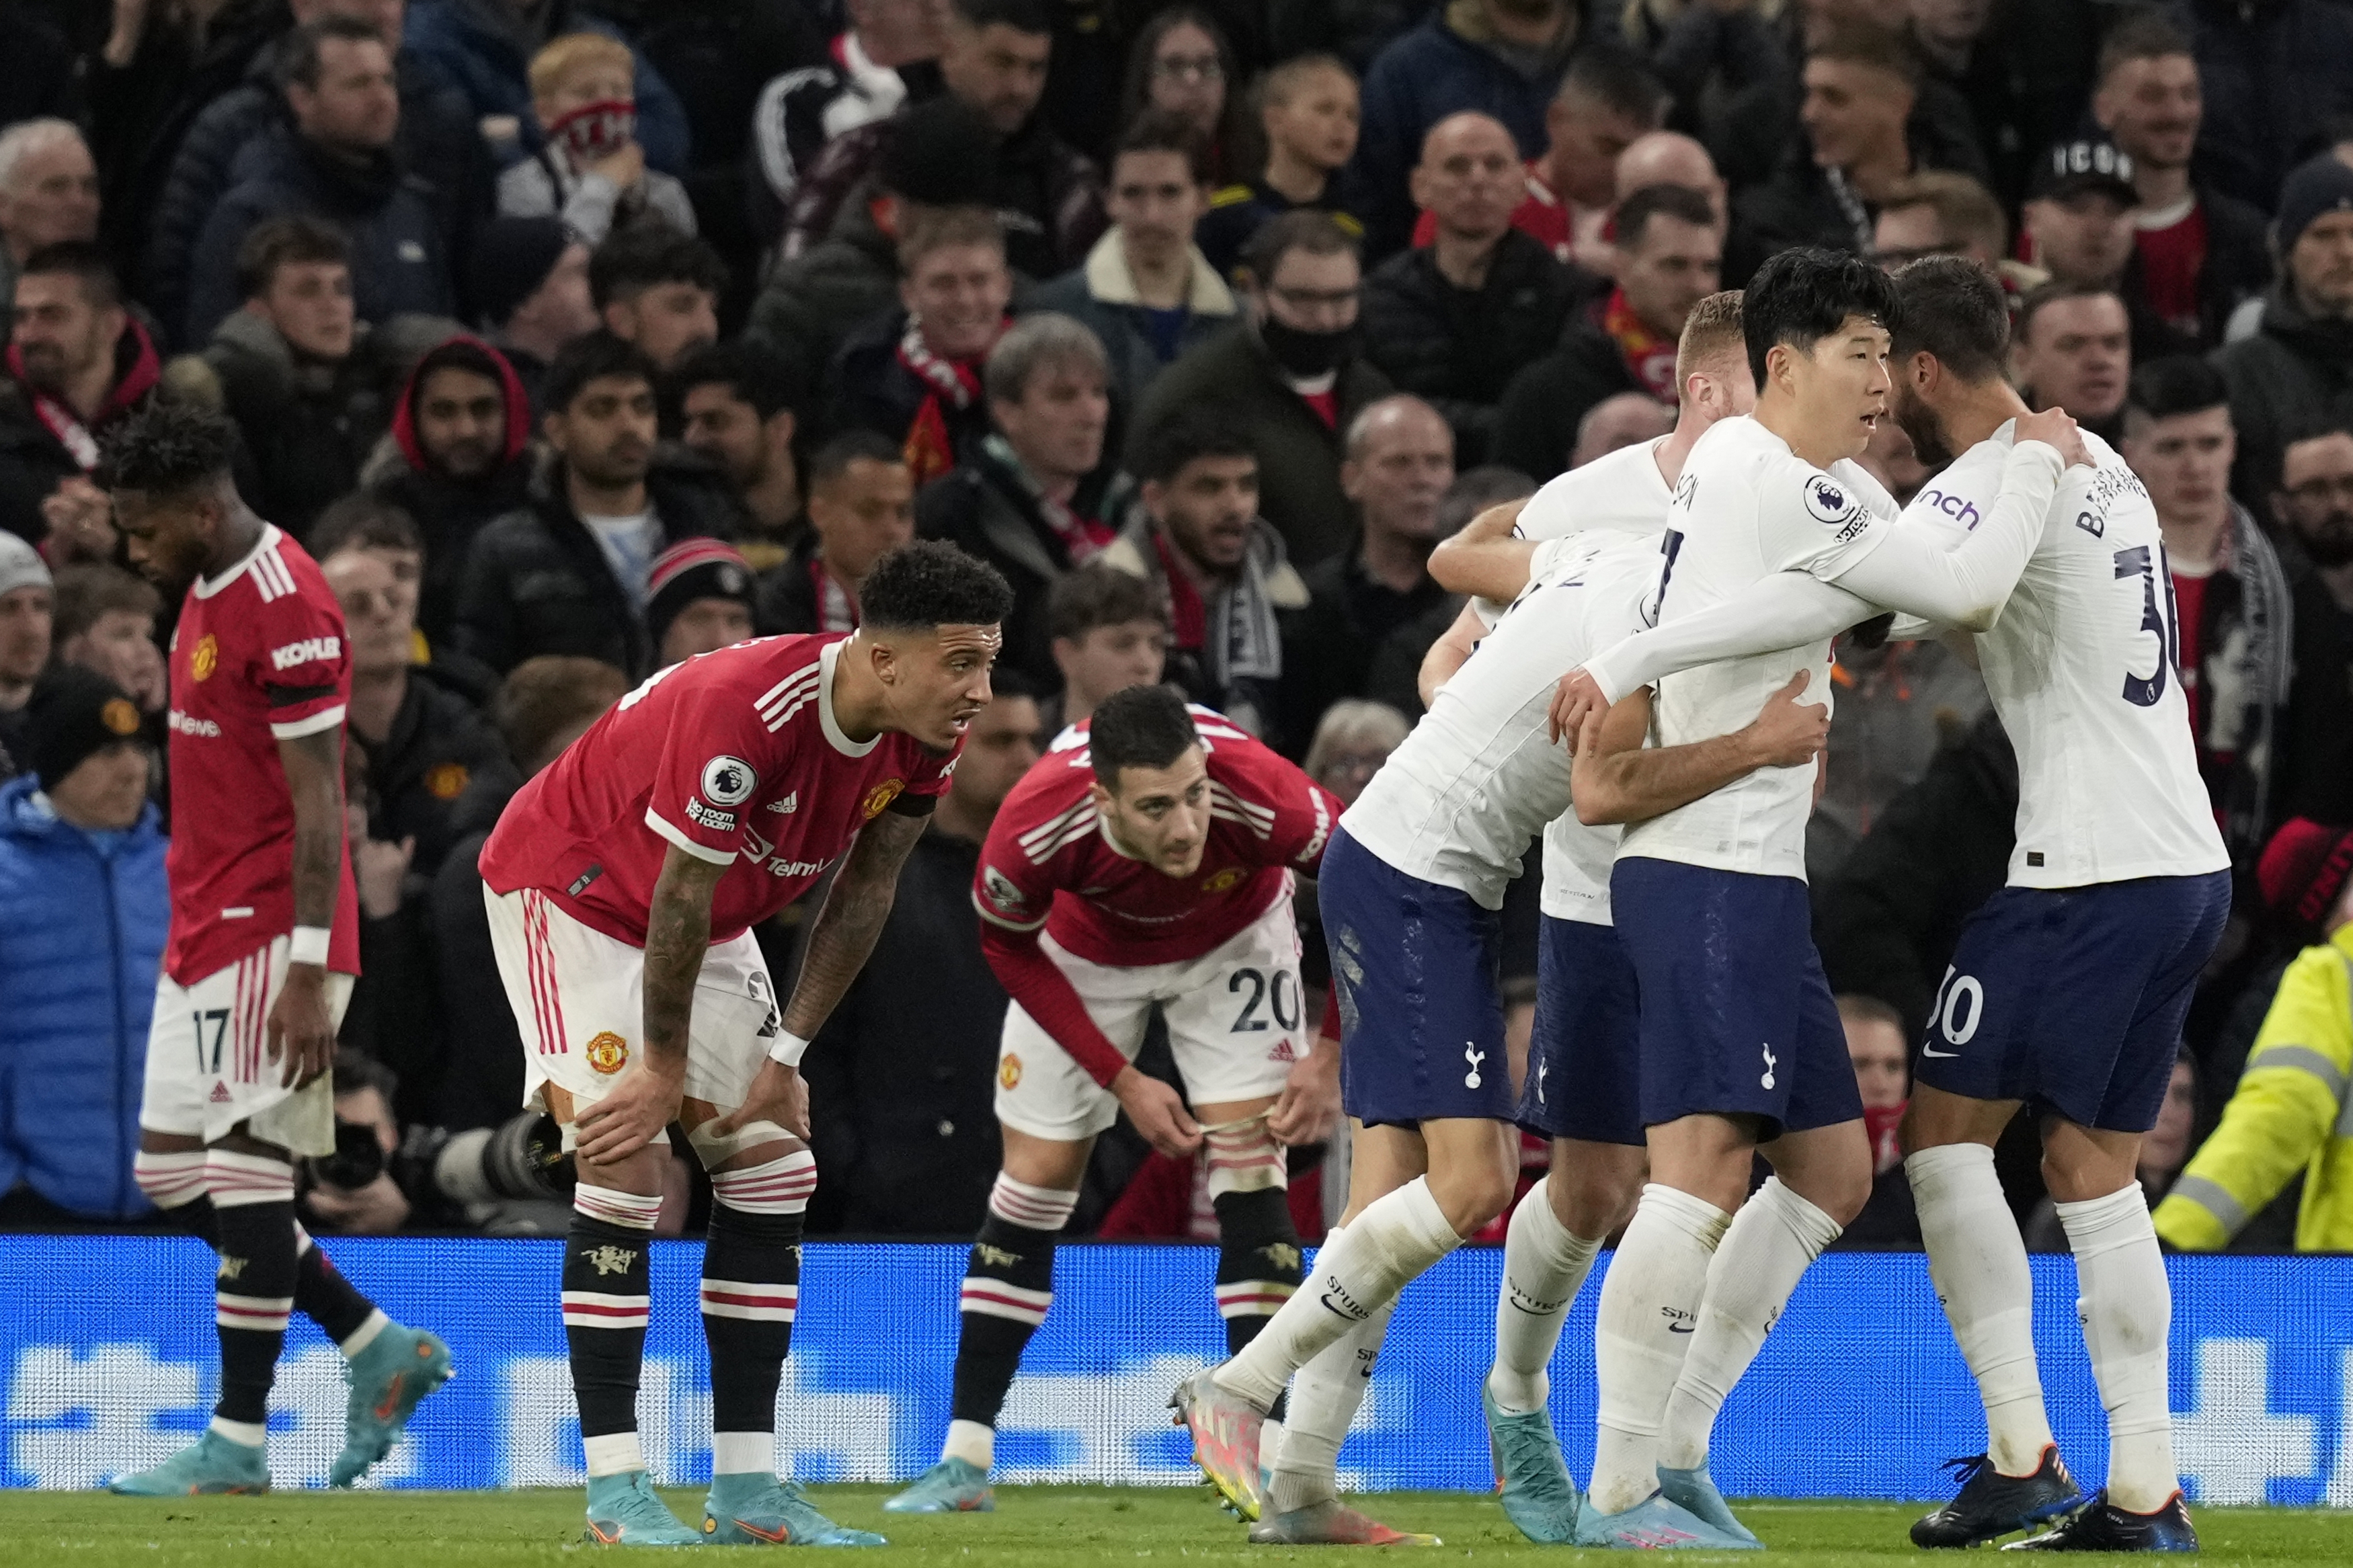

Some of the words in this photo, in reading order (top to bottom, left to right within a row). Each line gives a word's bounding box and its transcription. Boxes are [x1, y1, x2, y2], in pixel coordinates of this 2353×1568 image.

[703, 808, 734, 823] room
[1229, 968, 1300, 1033] 20
[194, 1008, 230, 1074] 17
